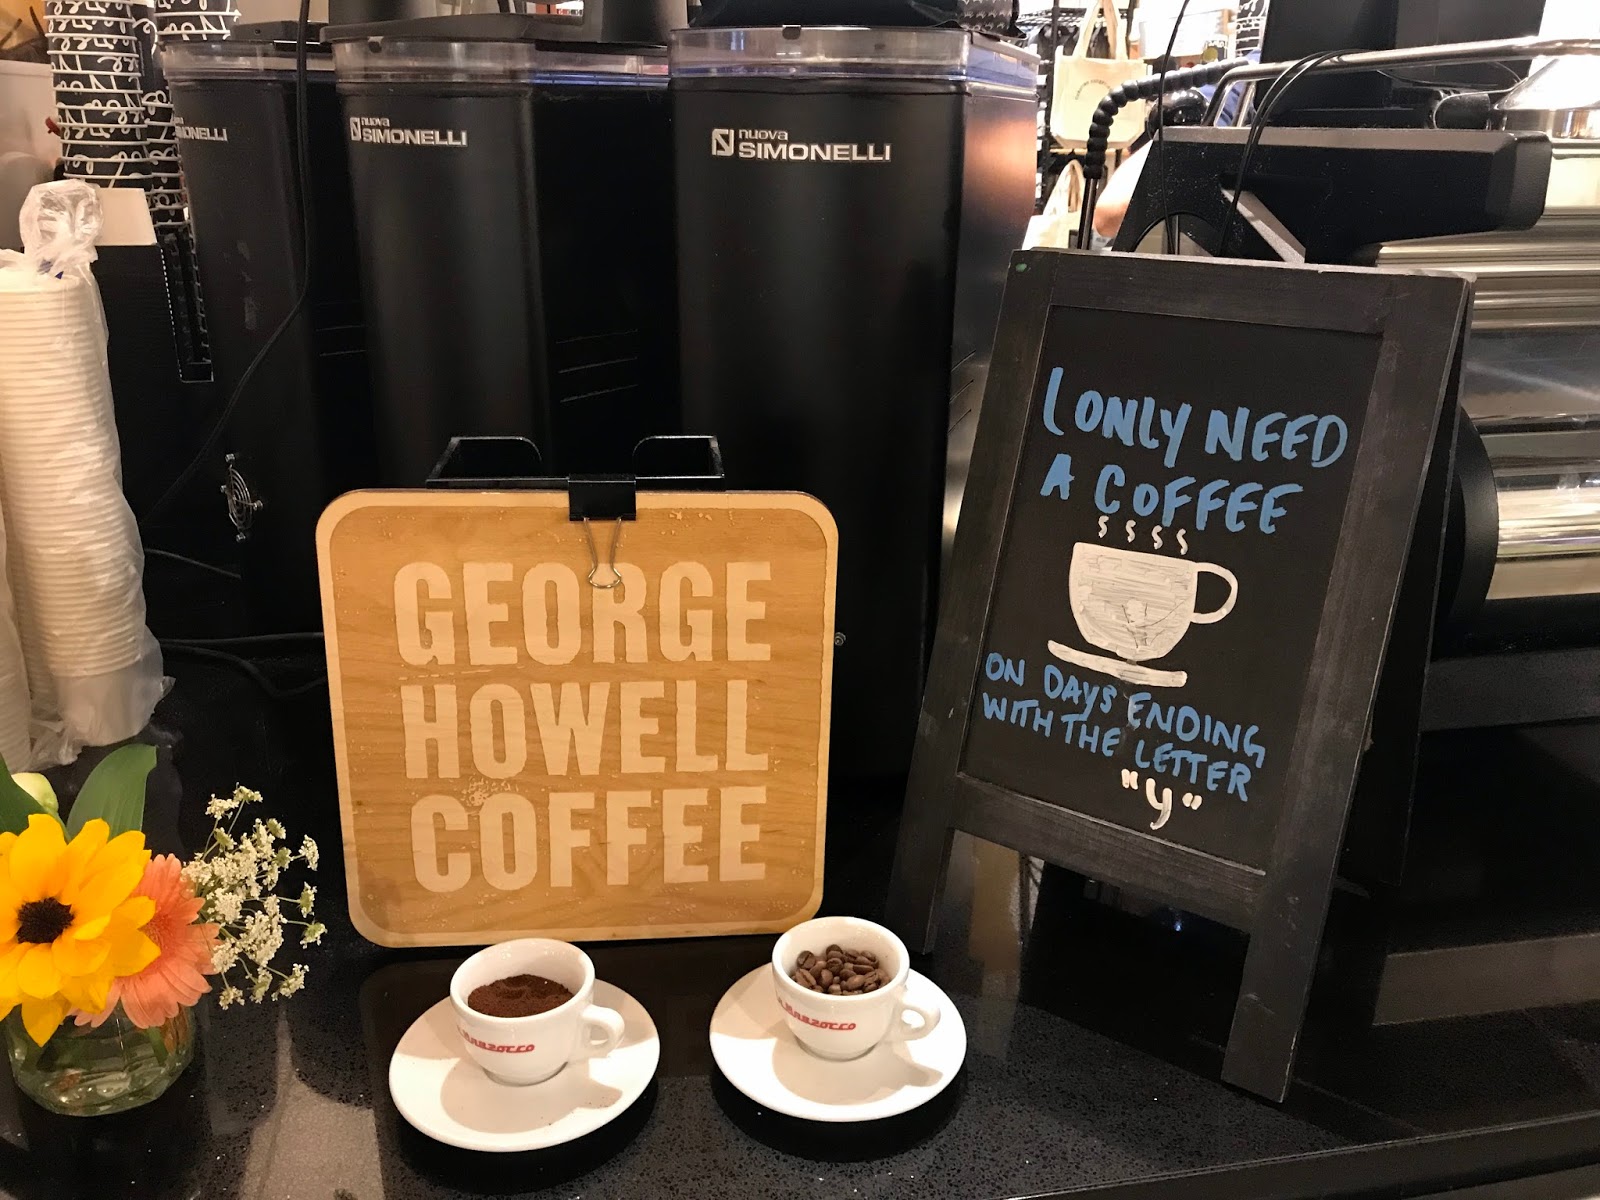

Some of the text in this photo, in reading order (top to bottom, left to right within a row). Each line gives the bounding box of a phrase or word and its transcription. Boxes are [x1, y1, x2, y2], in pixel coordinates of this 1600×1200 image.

[361, 117, 390, 127] nuova
[362, 128, 467, 146] SIMONELLI
[738, 129, 788, 140] nuova
[738, 142, 891, 161] SIMONELLI
[1074, 390, 1193, 469] ONLY
[1204, 406, 1348, 468] NEED
[1040, 453, 1304, 535] A COFFEE
[394, 561, 772, 666] GEORGE
[400, 679, 769, 780] HOWELL
[982, 692, 1252, 802] WITH THE LETTER
[985, 652, 1266, 769] ON DAYS ENDING
[410, 785, 768, 893] COFFEE
